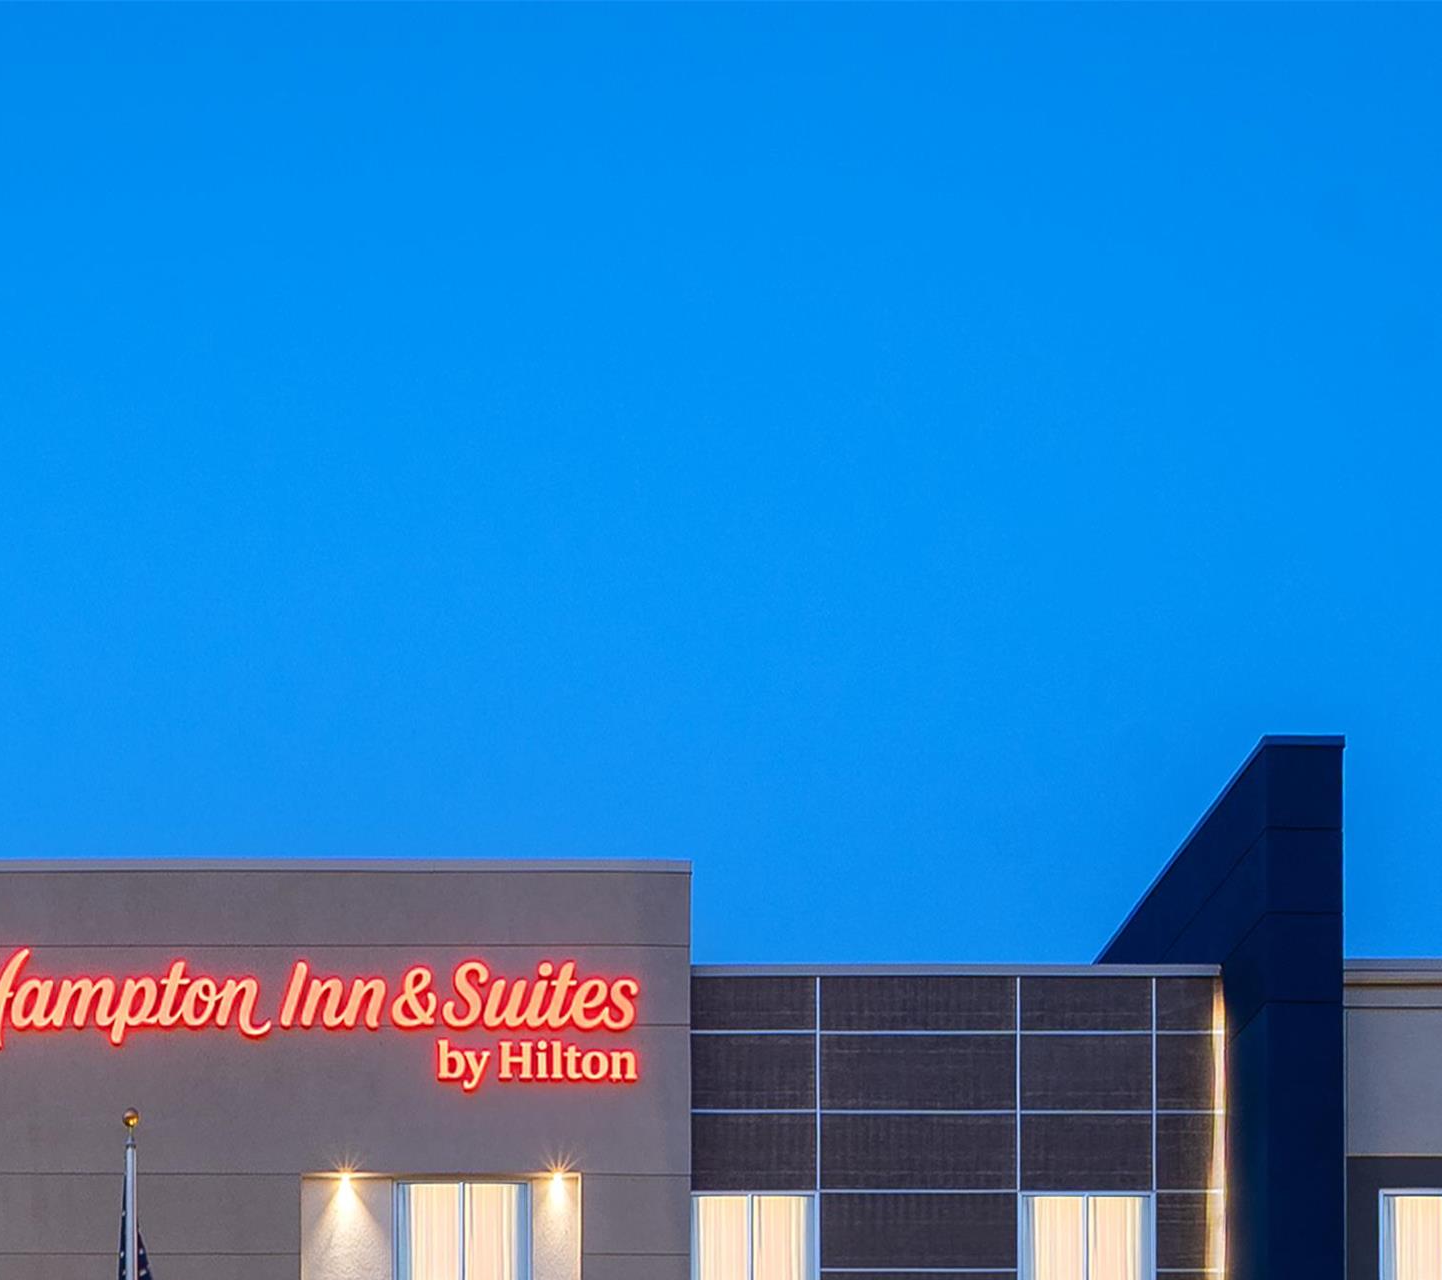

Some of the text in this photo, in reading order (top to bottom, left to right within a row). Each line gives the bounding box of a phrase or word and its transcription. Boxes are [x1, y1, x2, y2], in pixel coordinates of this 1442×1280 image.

[279, 960, 386, 1029] Inn
[442, 959, 640, 1032] Suites
[437, 1038, 639, 1090] by Hilton
